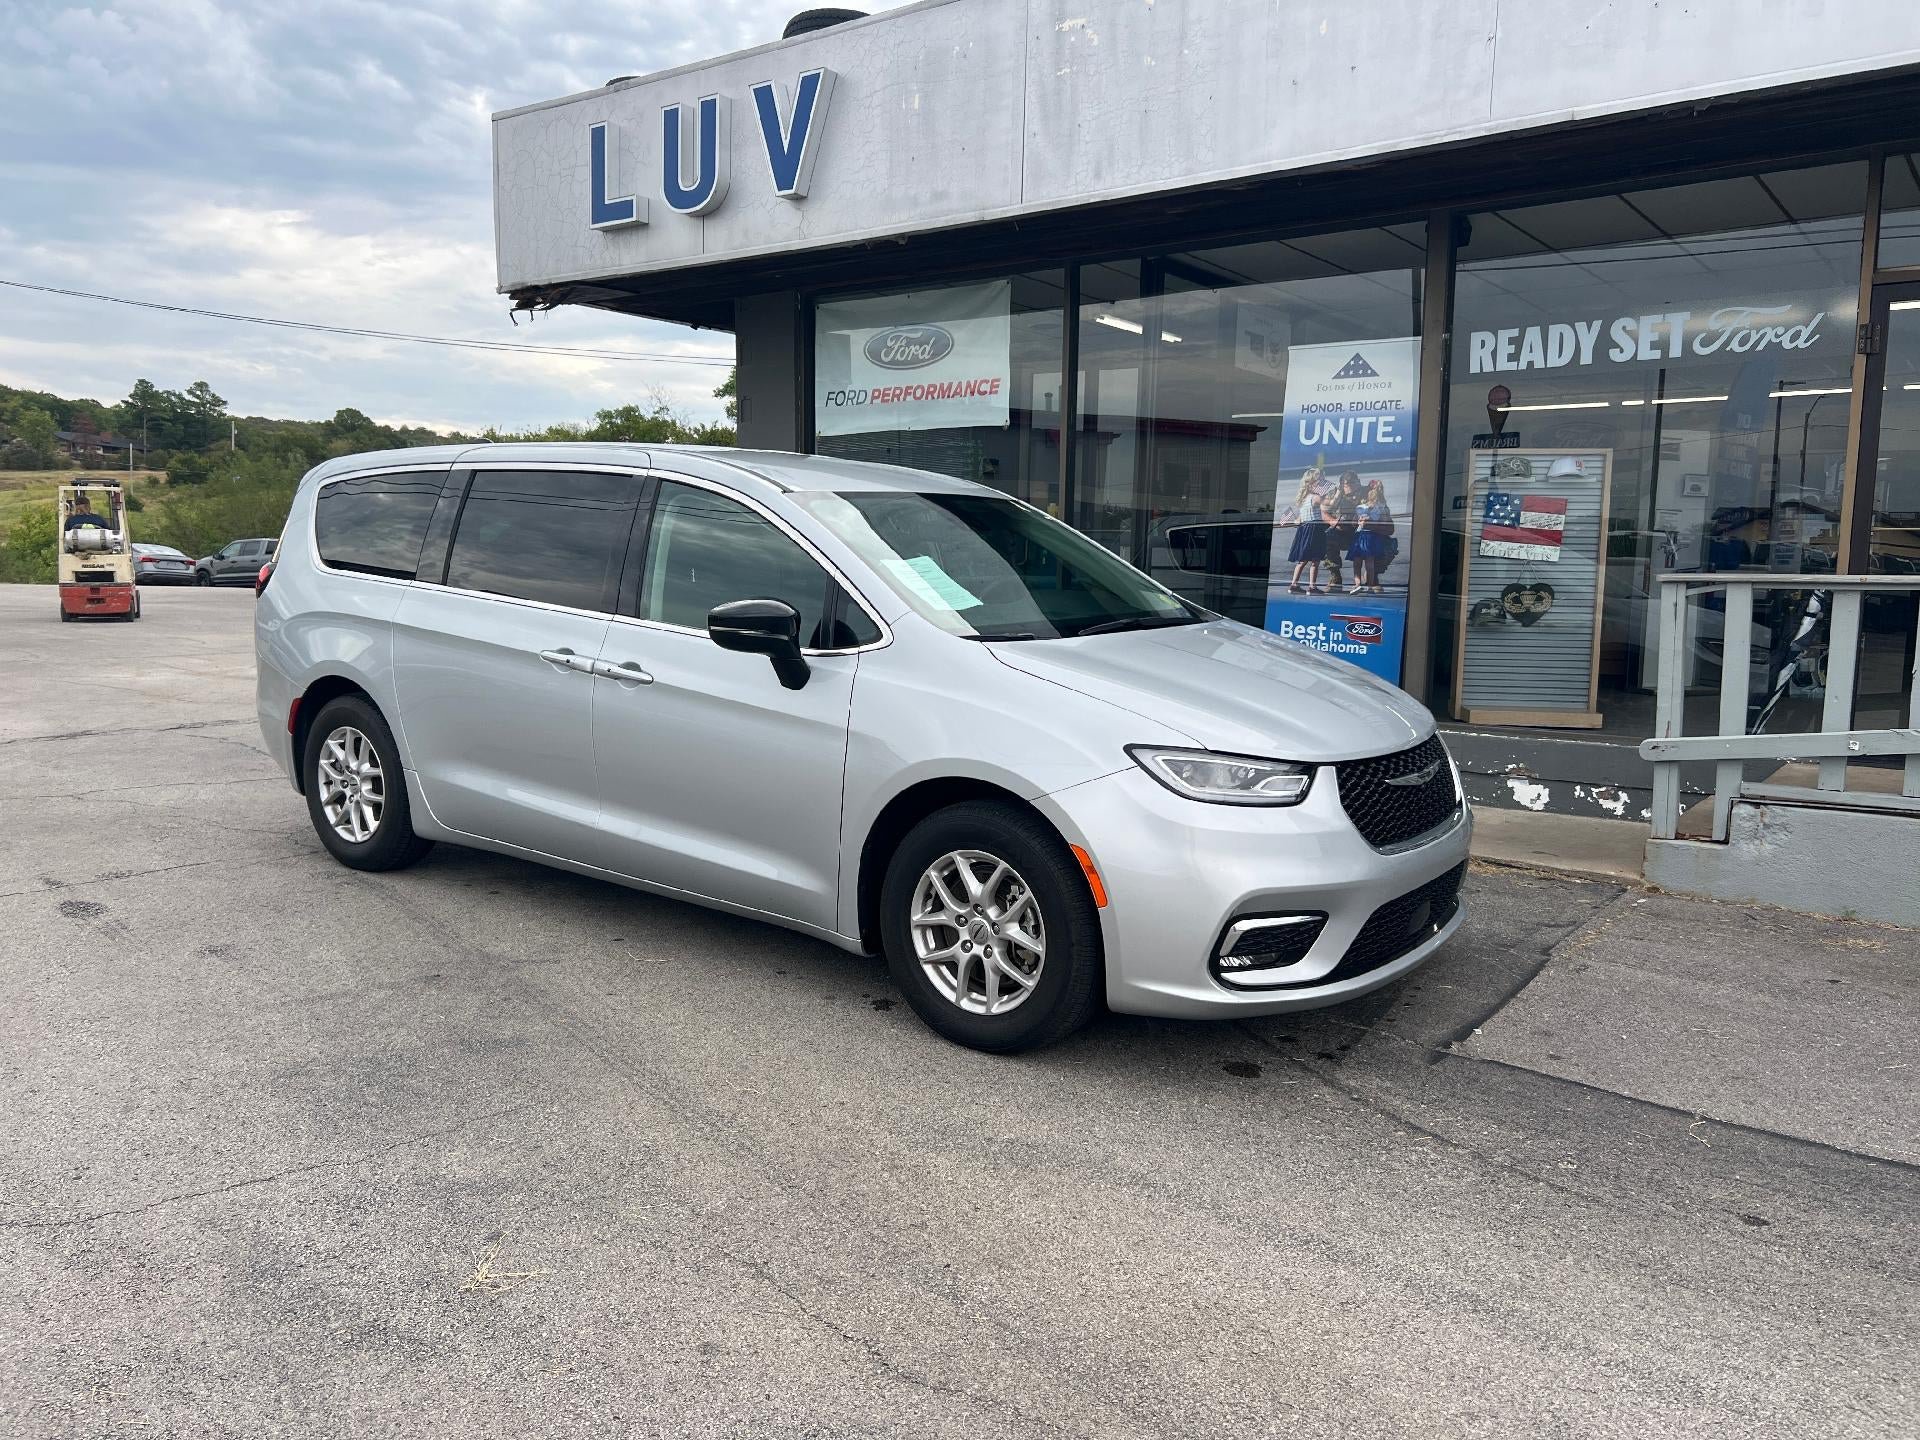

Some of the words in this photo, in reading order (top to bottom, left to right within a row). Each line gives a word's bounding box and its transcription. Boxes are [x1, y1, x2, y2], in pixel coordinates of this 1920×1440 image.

[588, 67, 838, 230] LUV
[1469, 319, 1602, 374] READY
[1608, 311, 1691, 363] SET
[1692, 304, 1826, 356] Ford
[826, 389, 867, 407] FORD
[869, 378, 1002, 405] PERFORMANCE
[1301, 402, 1346, 414] HONOR.
[1349, 400, 1405, 412] EDUCATE.
[1299, 415, 1402, 446] UNITE.
[1280, 620, 1327, 641] Best
[1329, 629, 1342, 641] in
